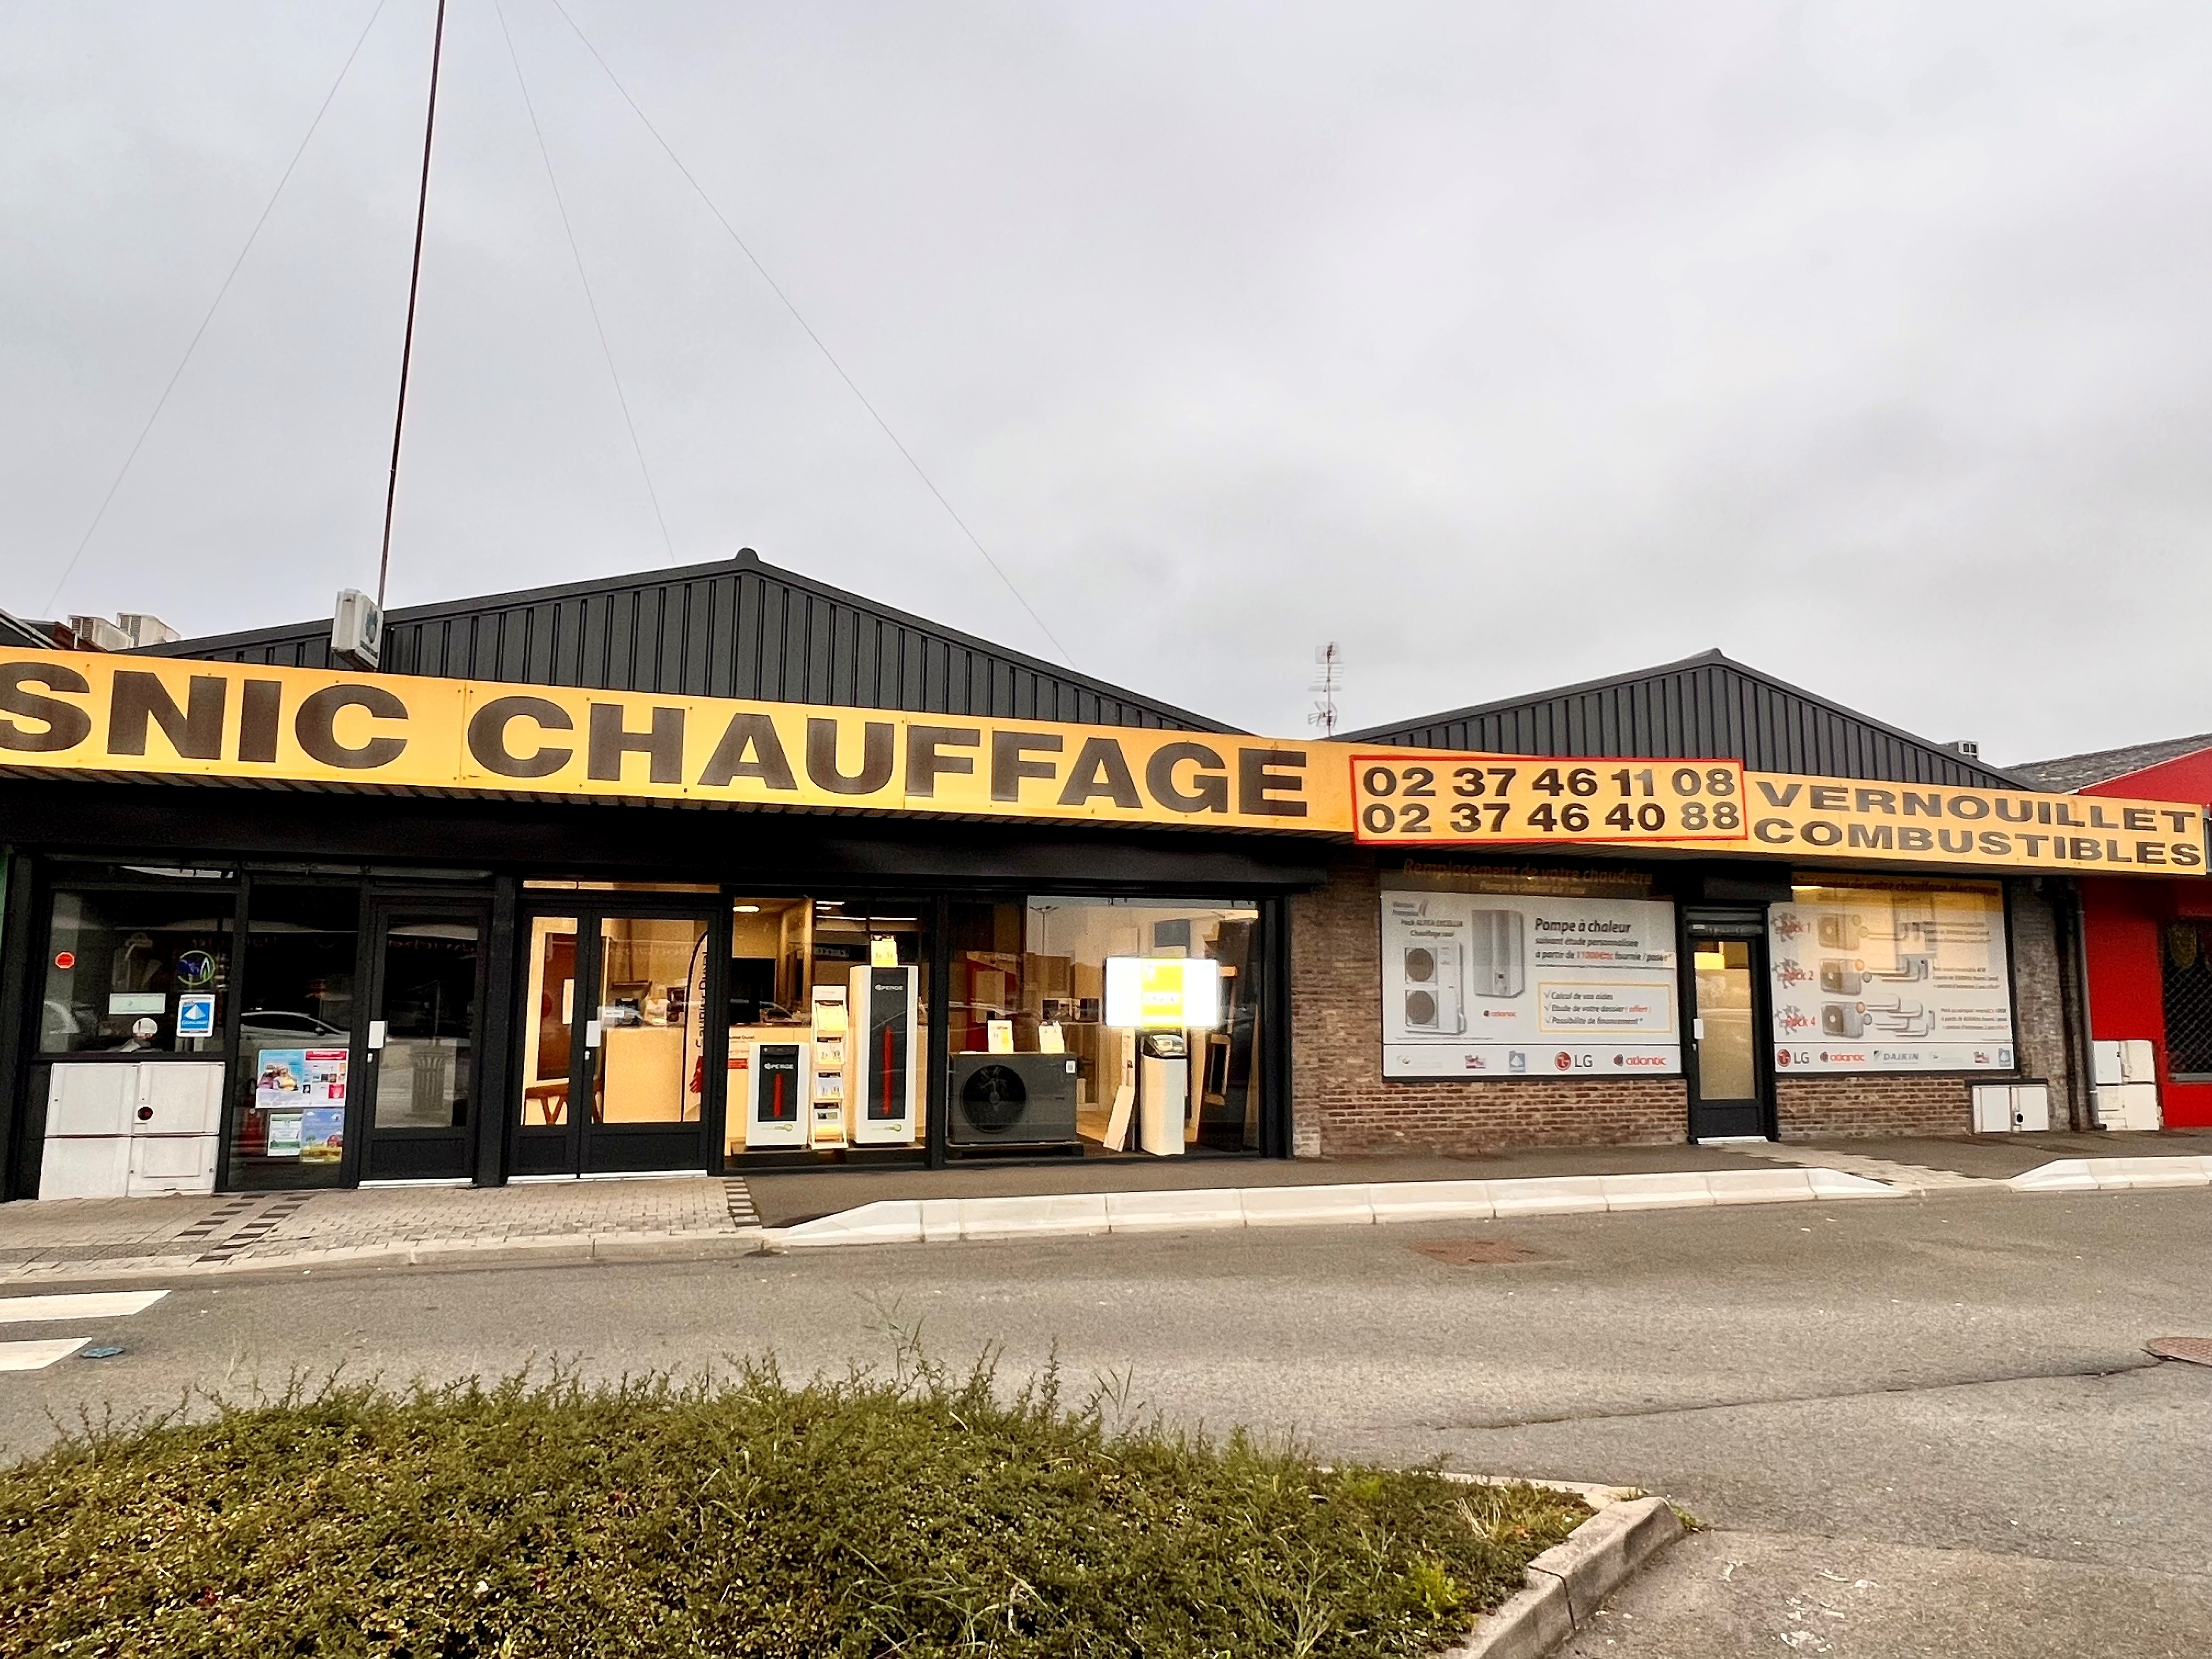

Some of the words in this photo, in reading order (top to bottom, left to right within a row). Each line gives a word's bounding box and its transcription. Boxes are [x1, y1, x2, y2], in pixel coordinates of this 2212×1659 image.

[0, 662, 409, 769] SNIC
[467, 696, 1307, 817] CHAUFFAGE
[1363, 767, 1436, 797] 02
[1452, 767, 1516, 797] 37
[1532, 768, 1598, 797] 46
[1611, 768, 1655, 797] 11
[1671, 768, 1735, 797] 08
[1363, 803, 1432, 833] 02
[1449, 802, 1510, 833] 37
[1527, 803, 1590, 832] 46
[1604, 803, 1666, 832] 40
[1680, 801, 1740, 831] 88
[1756, 781, 2196, 833] VERNOUILLET
[1753, 817, 2202, 866] COMBUSTIBLES
[1535, 918, 1576, 934] Pompe
[1578, 919, 1585, 932] à
[1588, 919, 1632, 933] chaleur
[1574, 1054, 1593, 1068] LG
[1625, 1055, 1667, 1066] atlantic
[1793, 1051, 1809, 1064] LG
